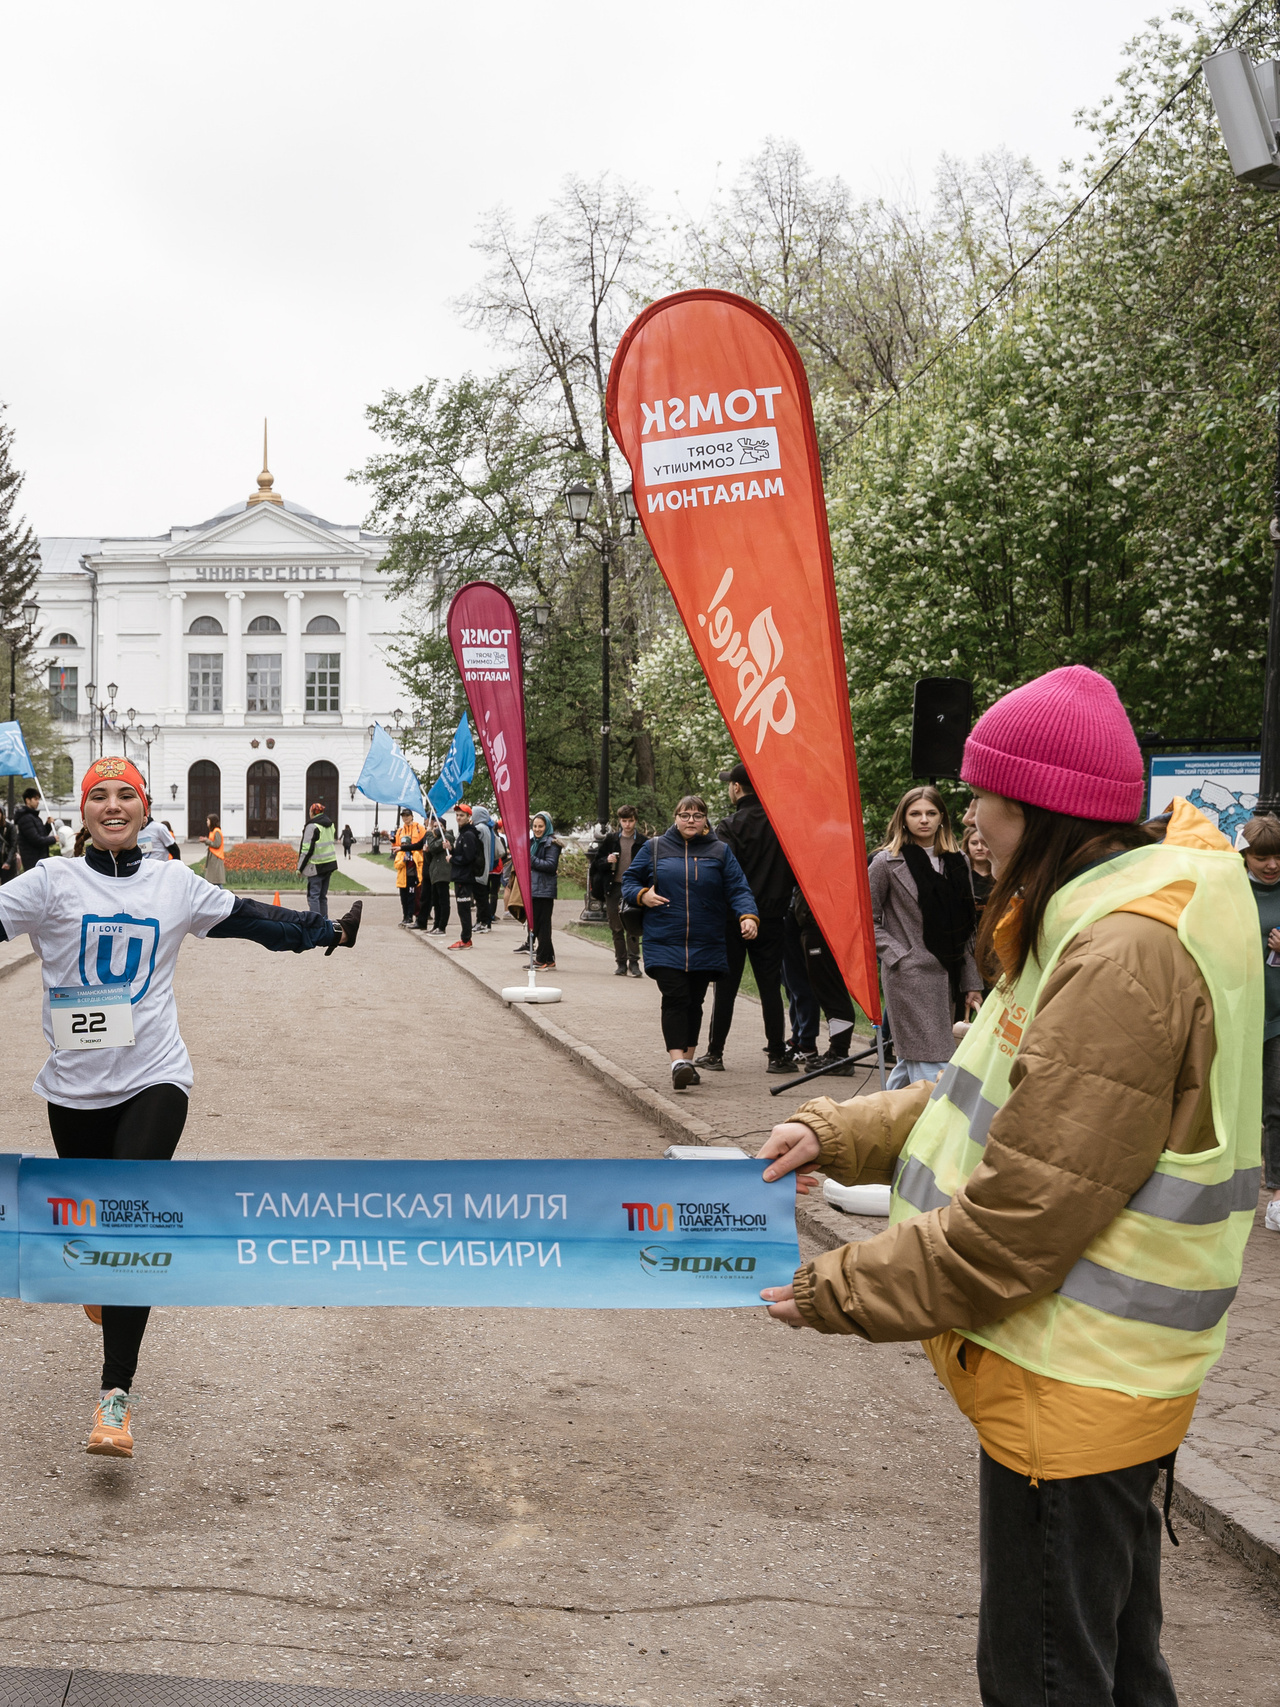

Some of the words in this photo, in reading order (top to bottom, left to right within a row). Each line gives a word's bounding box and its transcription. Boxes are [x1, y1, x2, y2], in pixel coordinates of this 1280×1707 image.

[196, 566, 341, 580] УНИВЕРСИТЕТ
[71, 1012, 107, 1034] 22
[99, 1199, 149, 1211] TOMSK
[235, 1192, 453, 1219] ТАМАНСКАЯ
[464, 1193, 567, 1220] МИЛЯ
[677, 1203, 730, 1215] TOMSK
[101, 1211, 183, 1223] MARATHON
[679, 1214, 766, 1227] MARATHON
[80, 1250, 172, 1267] ЭФКО
[237, 1239, 258, 1265] В
[267, 1239, 408, 1272] СЕРДЦЕ
[417, 1240, 562, 1268] СИБИРИ
[659, 1256, 757, 1273] ЭФКО
